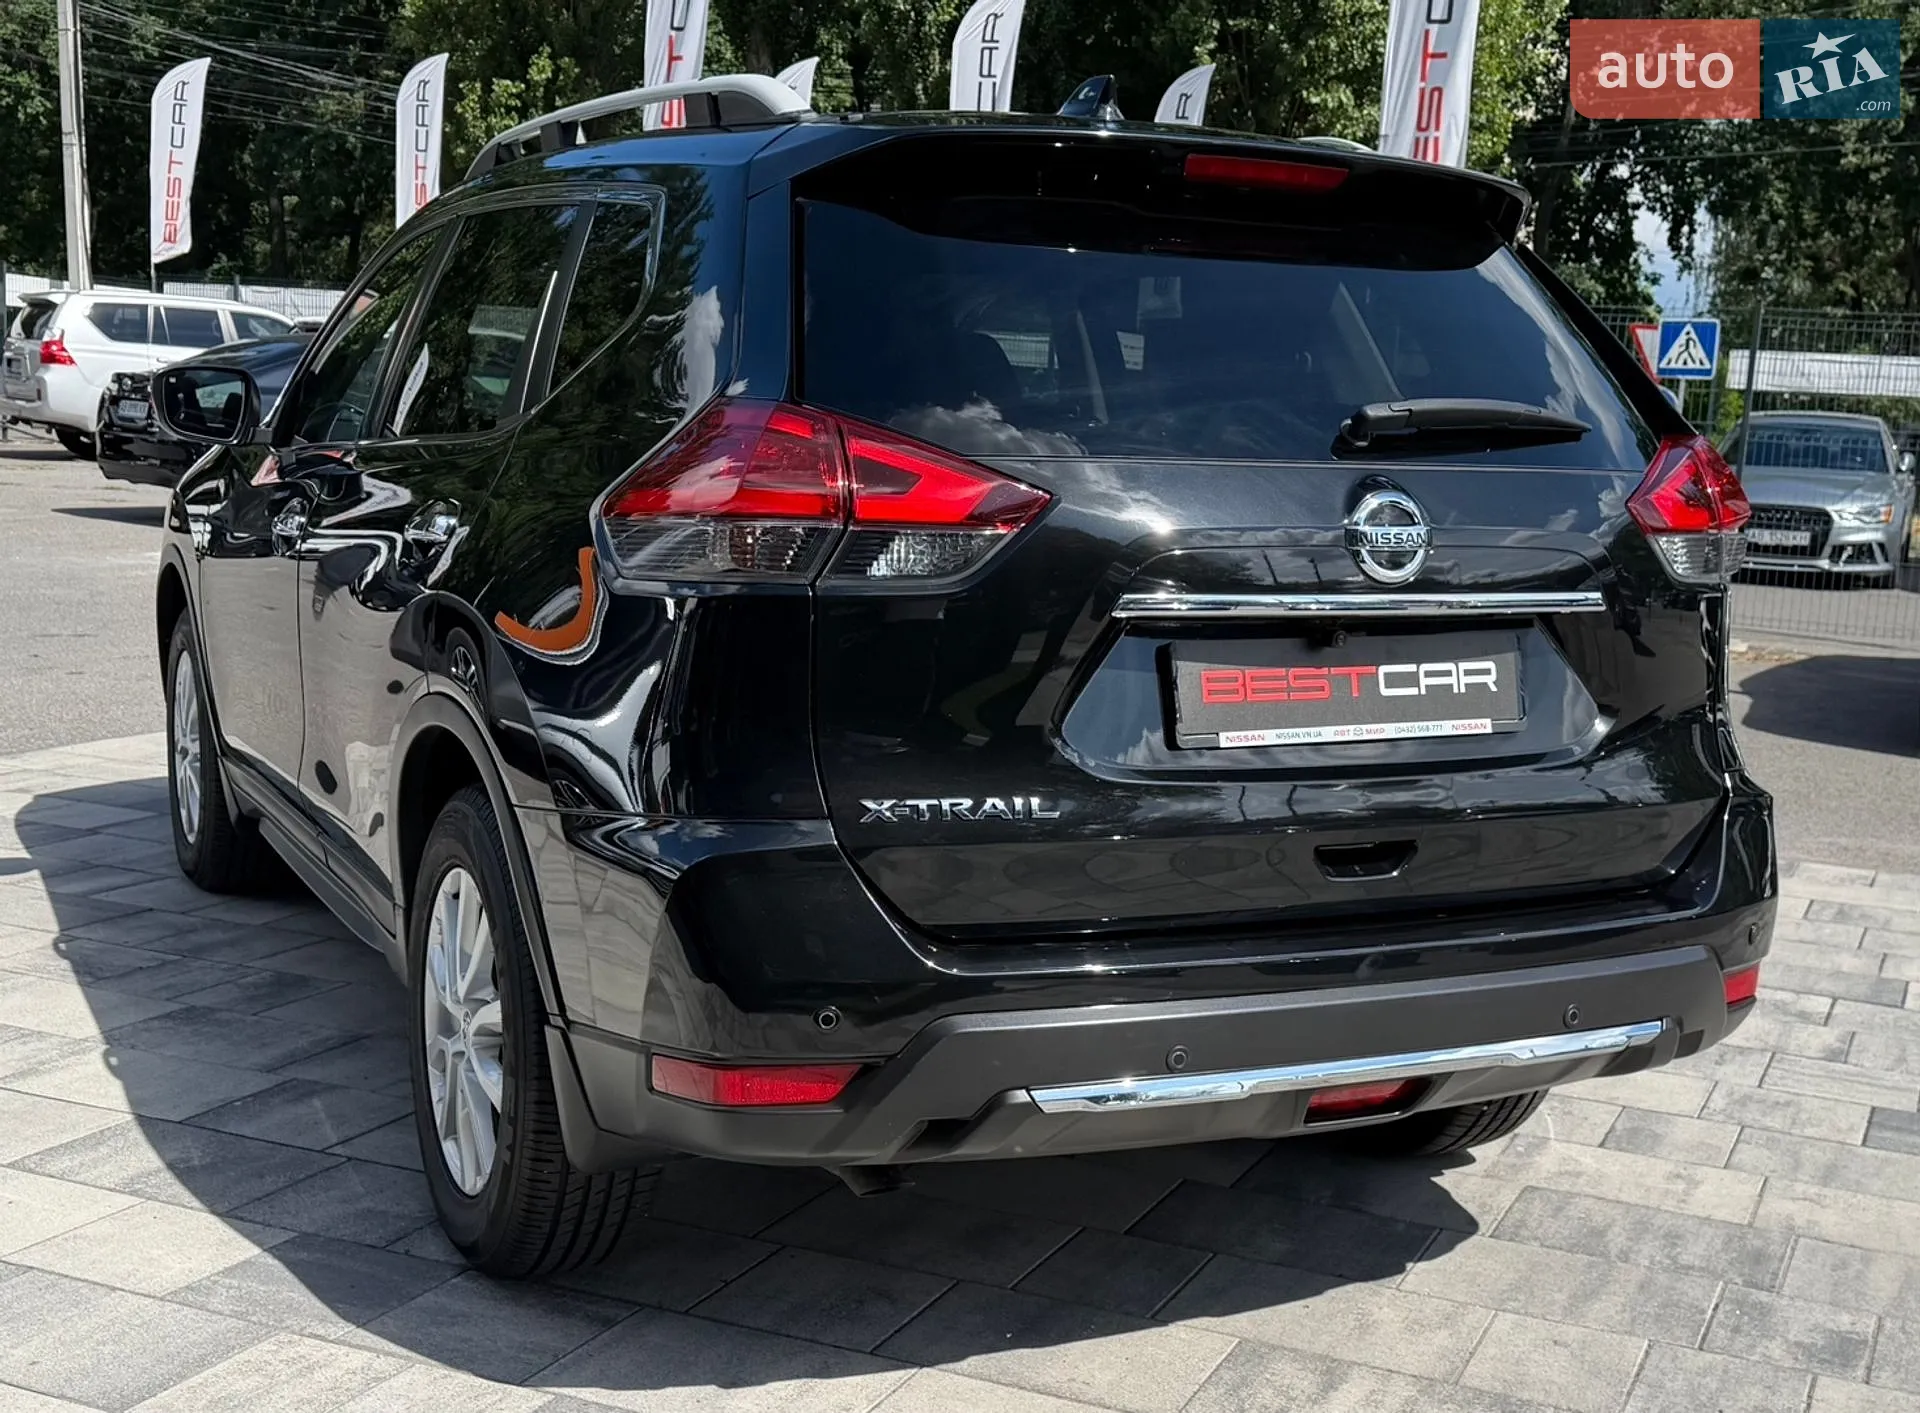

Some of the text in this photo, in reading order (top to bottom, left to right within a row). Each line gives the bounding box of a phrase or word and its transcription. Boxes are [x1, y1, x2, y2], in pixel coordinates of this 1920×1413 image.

[162, 78, 191, 245] BESTCAR
[1357, 531, 1427, 546] NISSAN
[1199, 660, 1499, 705] BESTCAR
[1225, 733, 1266, 744] NISSAN
[1451, 723, 1488, 732] NISSAN
[858, 796, 1061, 825] X-TRAIL
